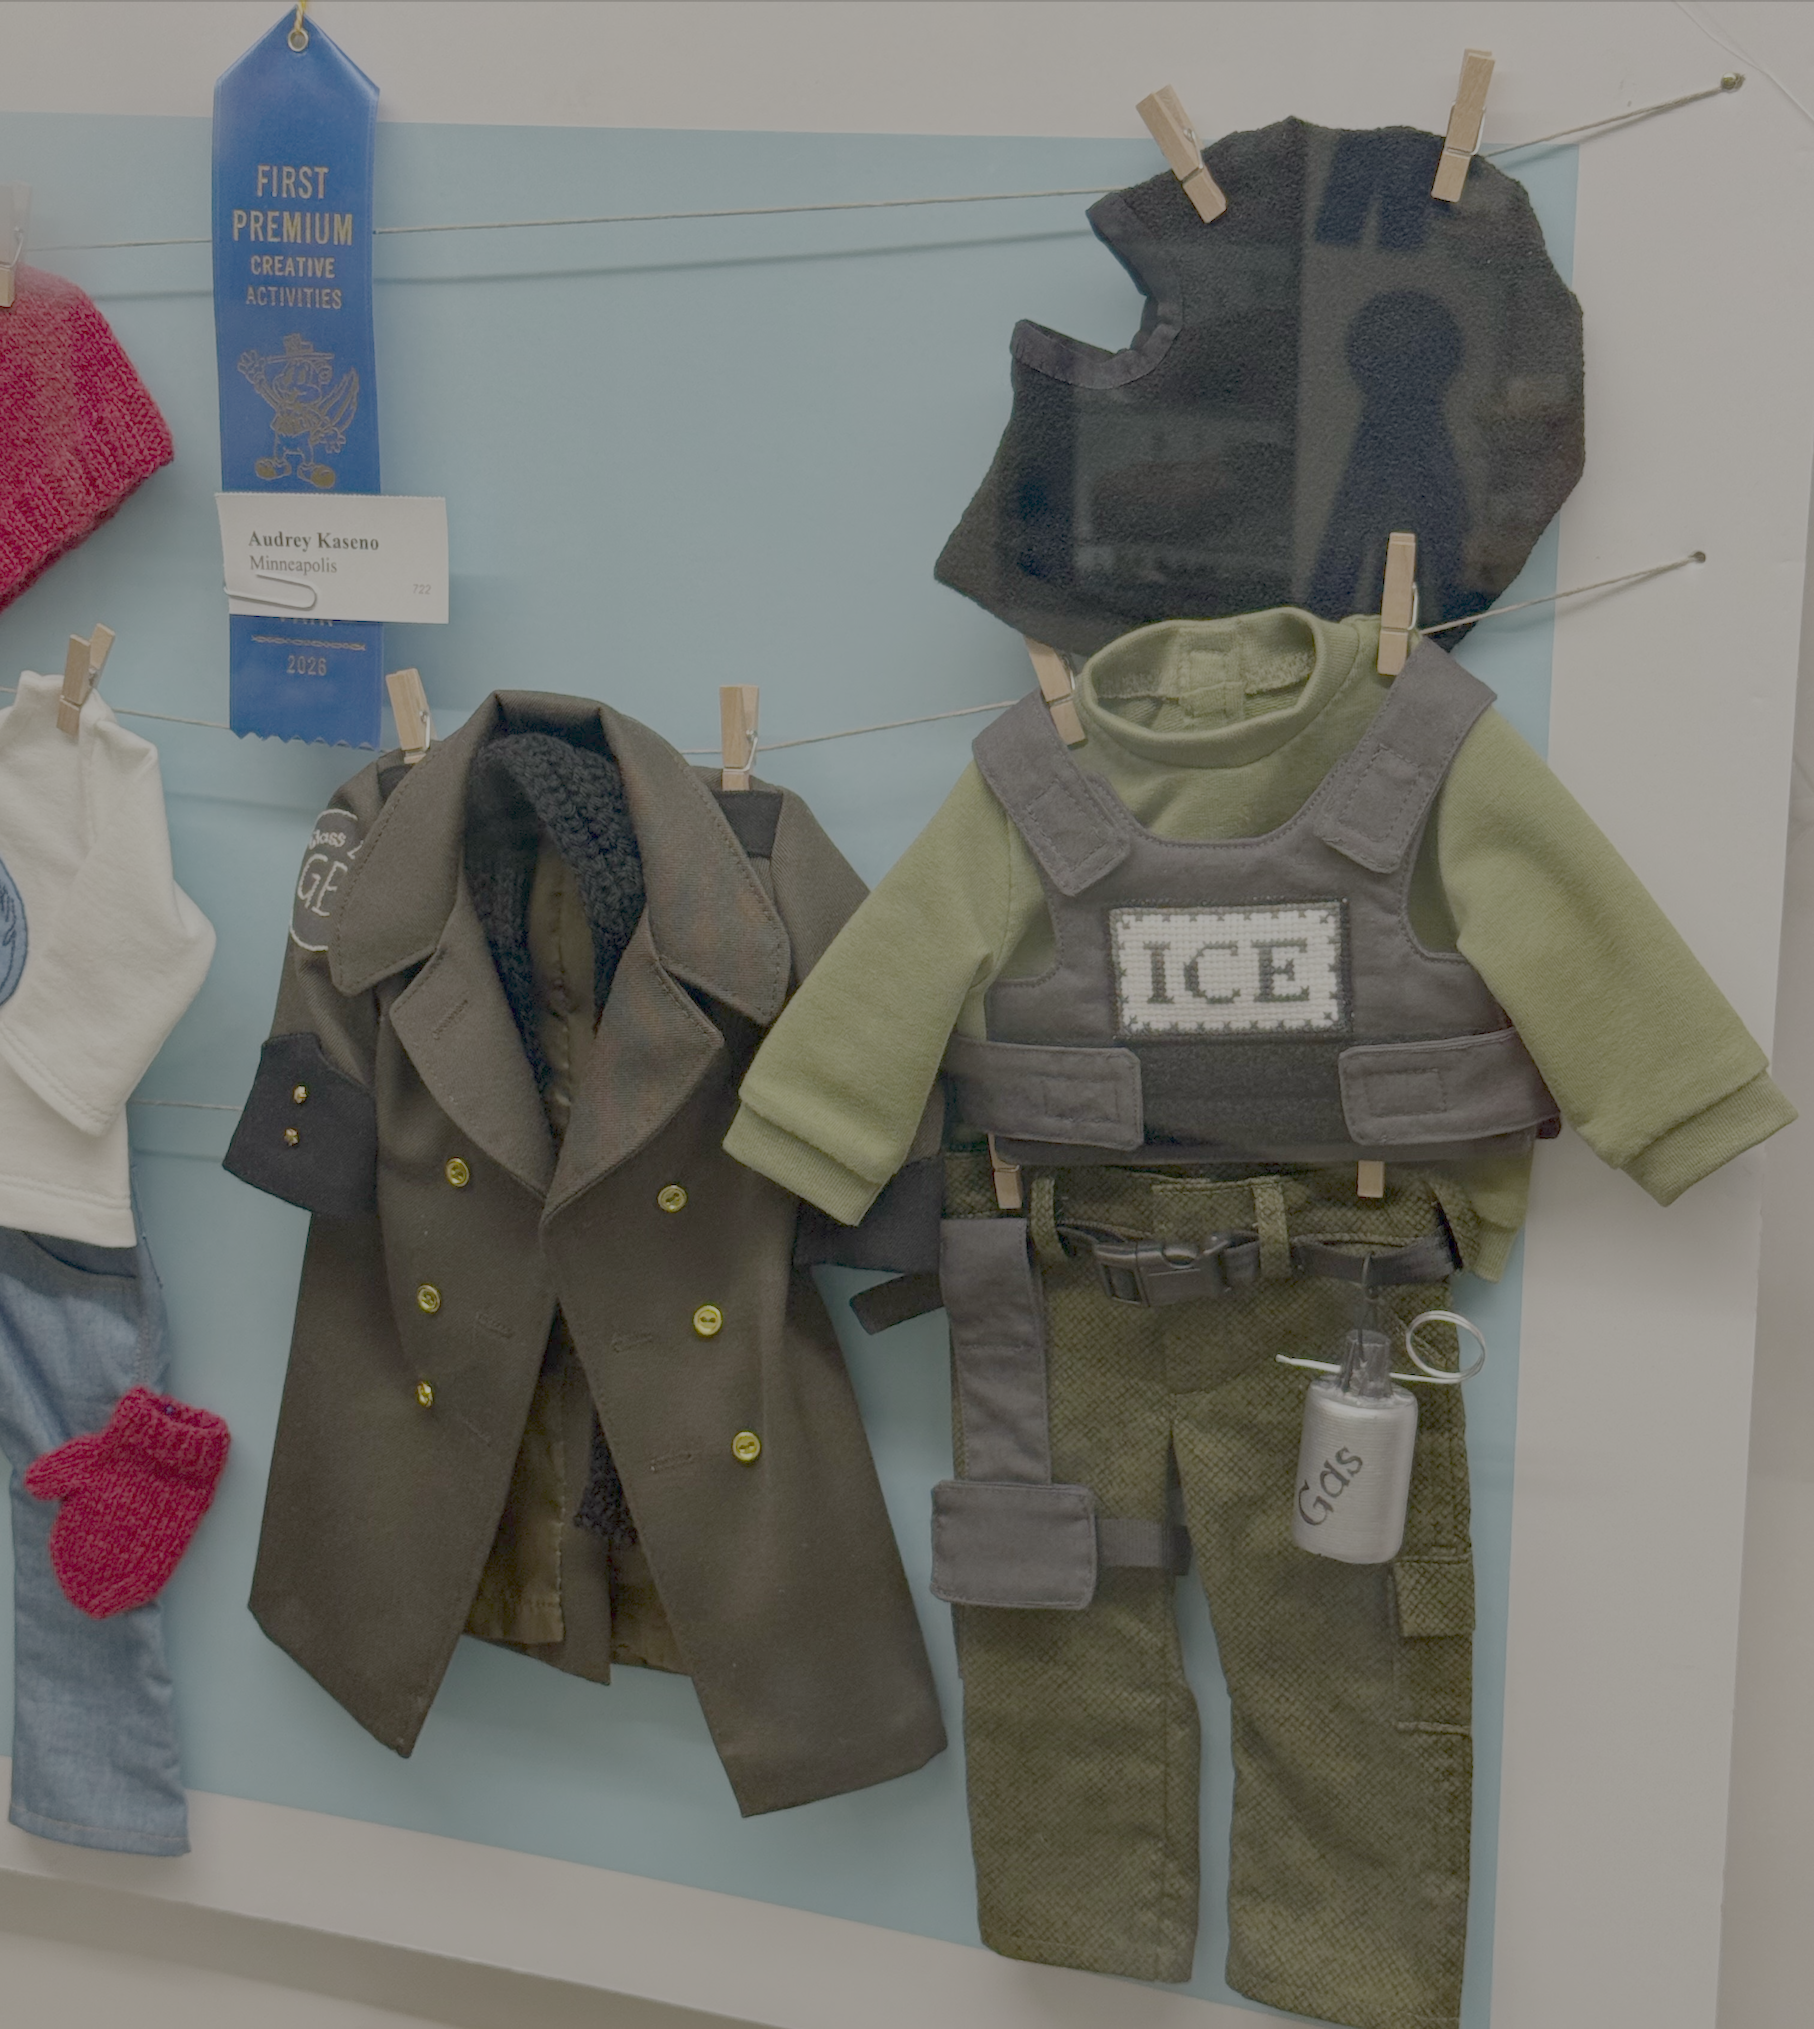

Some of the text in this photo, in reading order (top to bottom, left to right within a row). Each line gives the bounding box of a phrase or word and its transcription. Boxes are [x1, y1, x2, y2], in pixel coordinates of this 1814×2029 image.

[256, 164, 330, 200] FIRST
[232, 209, 354, 247] PREMIUM
[250, 254, 336, 280] CREATIVE
[245, 285, 343, 310] ACTIVITIES
[248, 530, 380, 553] Audrey Kaseno
[249, 554, 338, 576] Minneapolis
[411, 583, 432, 595] 722
[286, 655, 328, 677] 2026
[1143, 937, 1310, 1005] ICE
[1298, 1446, 1364, 1527] Gas
